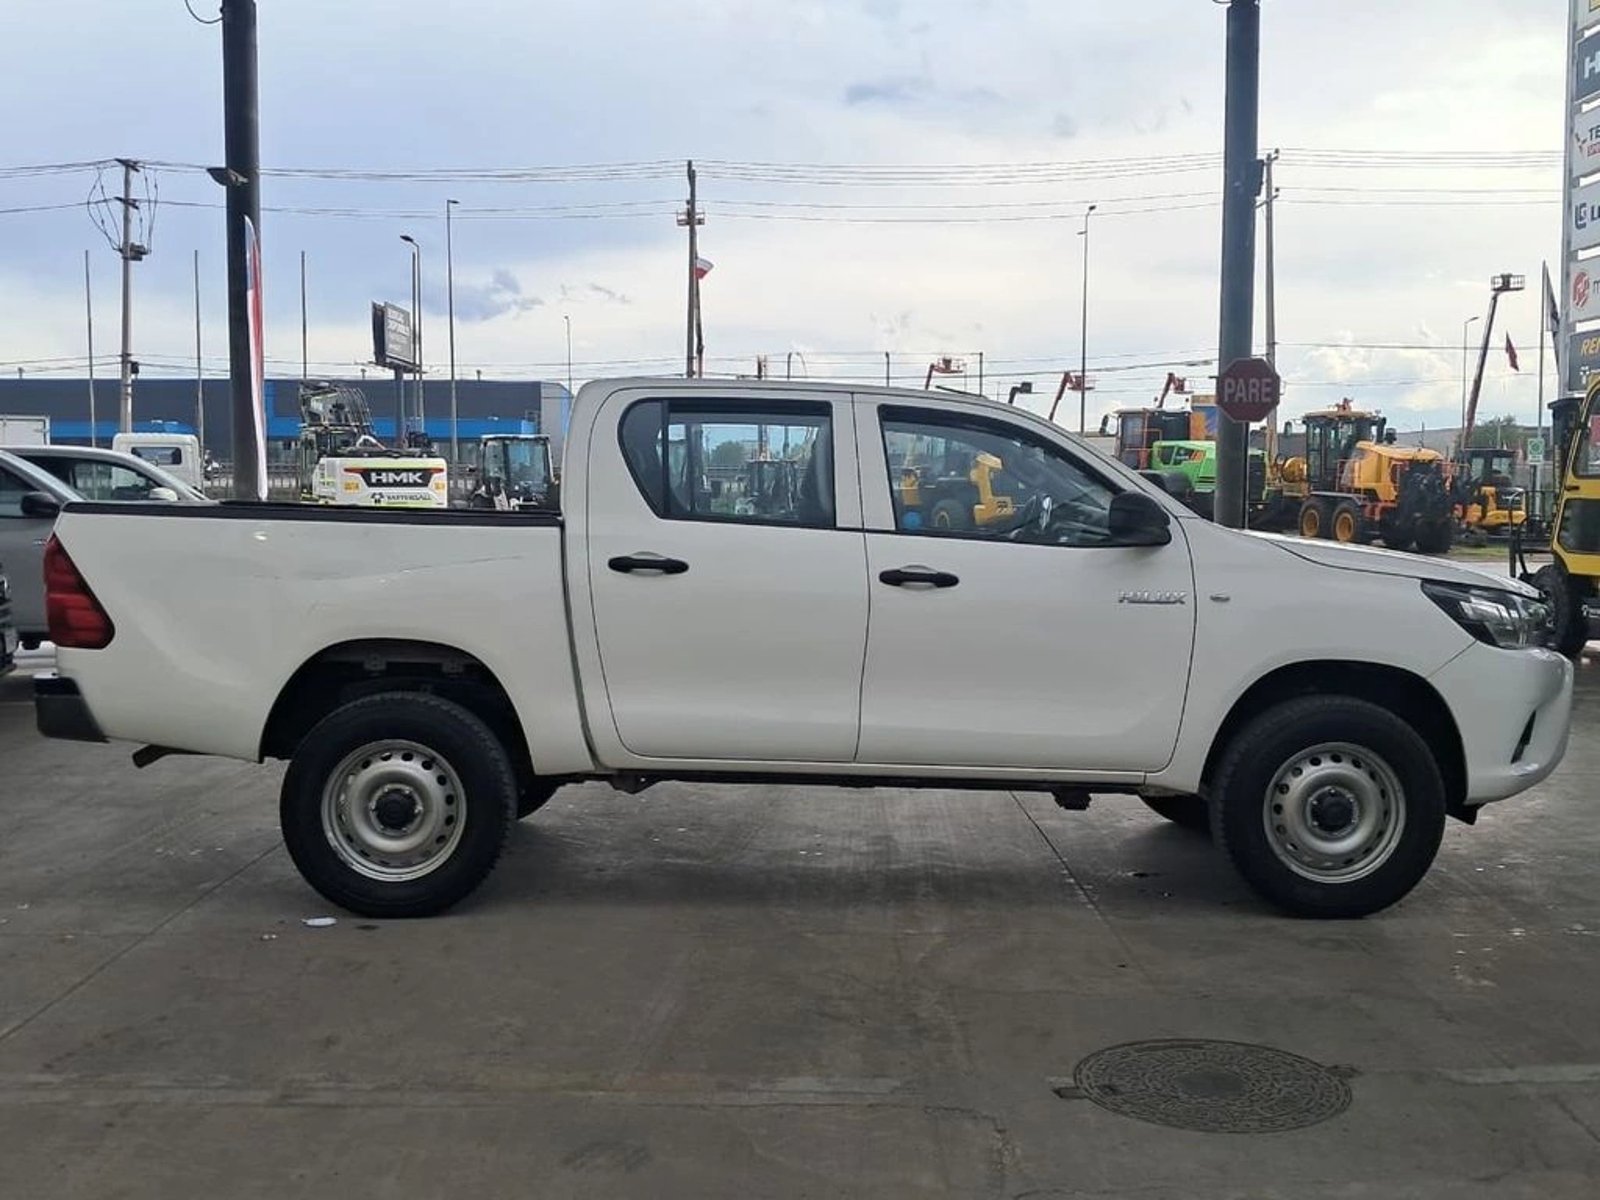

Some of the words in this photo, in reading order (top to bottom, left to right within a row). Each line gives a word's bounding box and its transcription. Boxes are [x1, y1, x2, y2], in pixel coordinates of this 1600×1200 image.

[1224, 377, 1273, 402] PARE
[370, 472, 423, 483] HMK
[1118, 591, 1187, 605] HILUX
